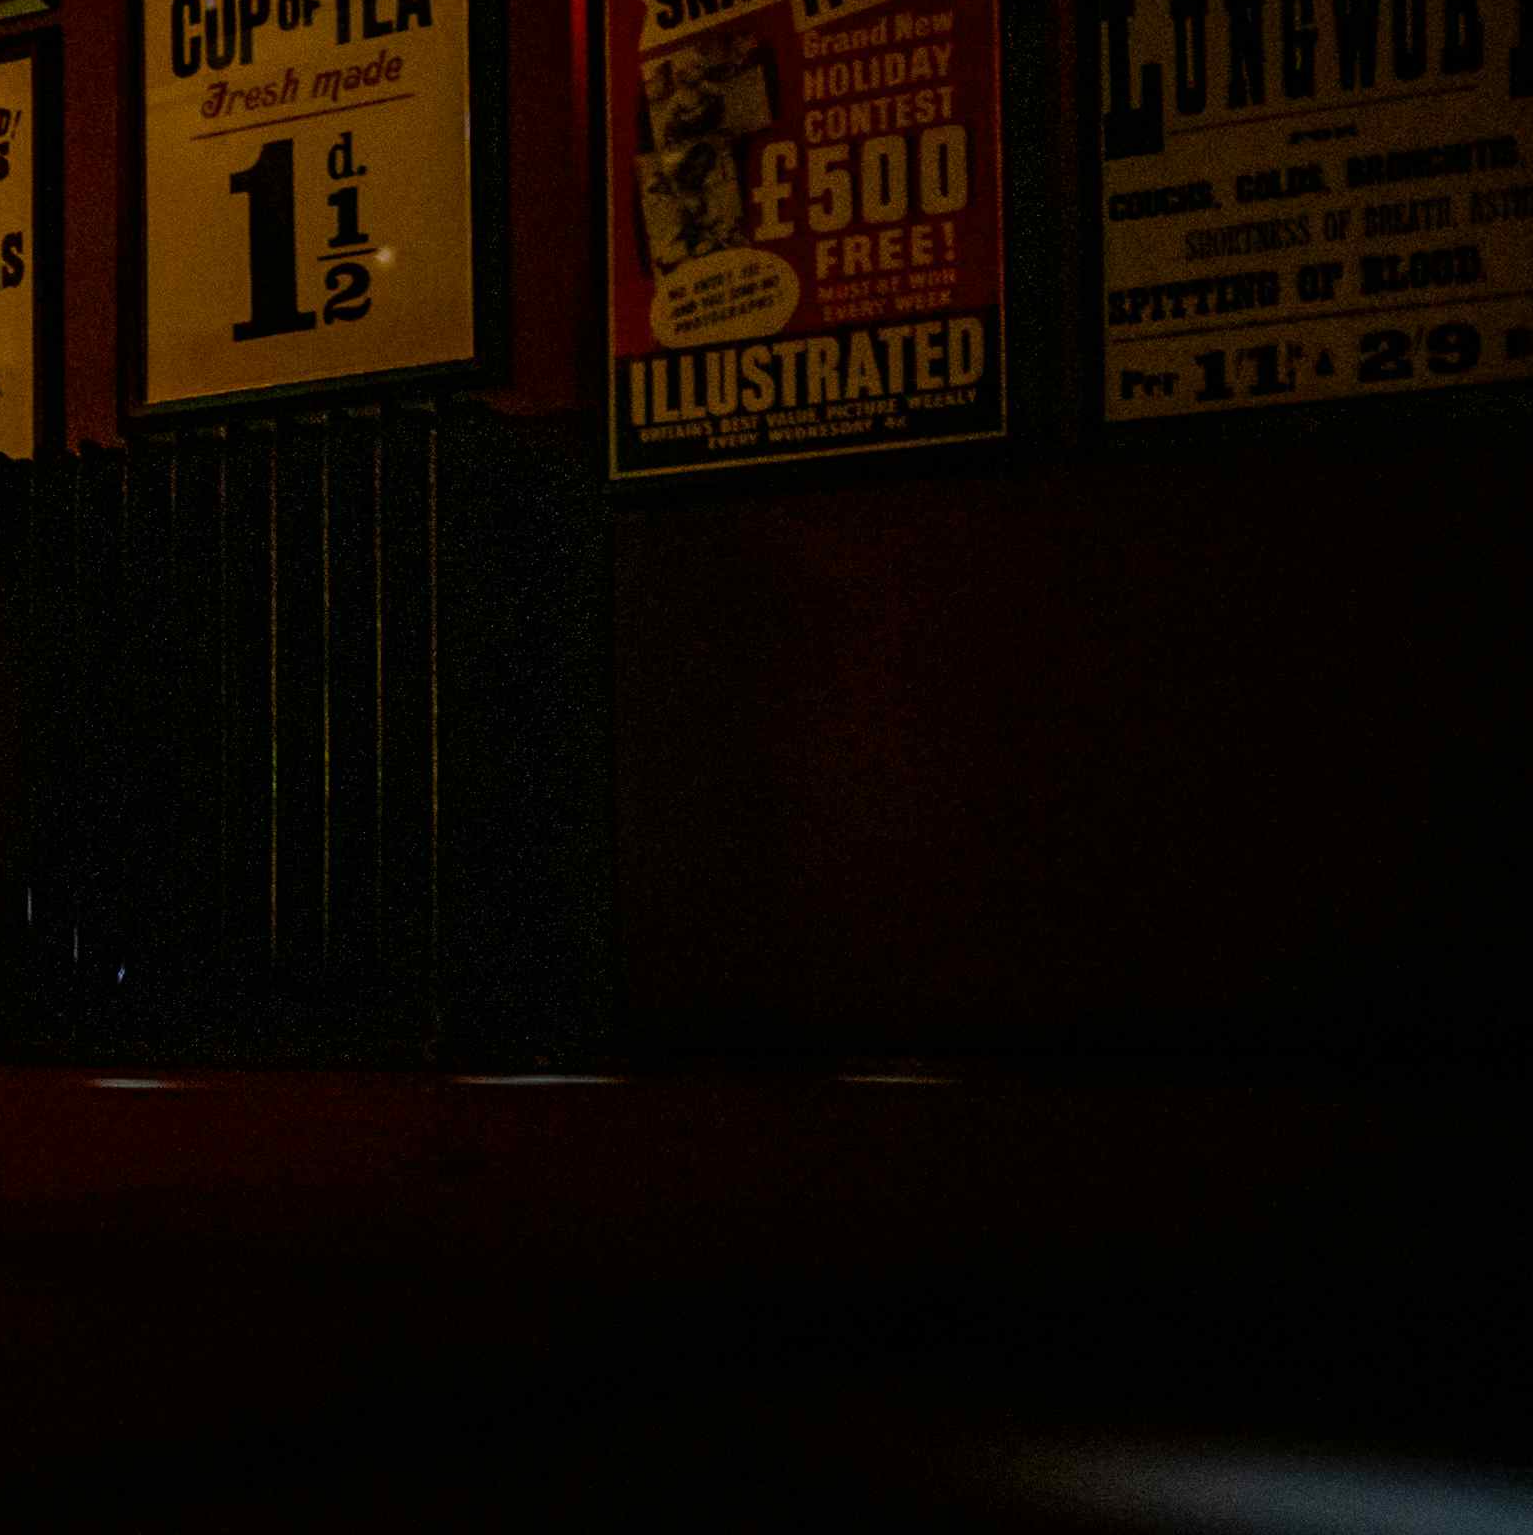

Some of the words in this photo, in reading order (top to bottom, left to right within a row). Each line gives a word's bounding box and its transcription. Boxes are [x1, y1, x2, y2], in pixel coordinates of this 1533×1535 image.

[803, 16, 888, 59] Brand
[894, 8, 954, 42] New
[200, 65, 301, 120] Fresh
[310, 49, 403, 100] made
[803, 41, 953, 103] HOLIDAY
[803, 85, 954, 144] CONTEST
[751, 124, 968, 242] £500
[815, 220, 956, 281] FREE!
[1322, 208, 1352, 242] OF
[1108, 270, 1281, 326] SPITTING
[1295, 261, 1344, 303] OF
[629, 316, 986, 427] ILLUSTRATED
[905, 387, 977, 411] WEEKLY
